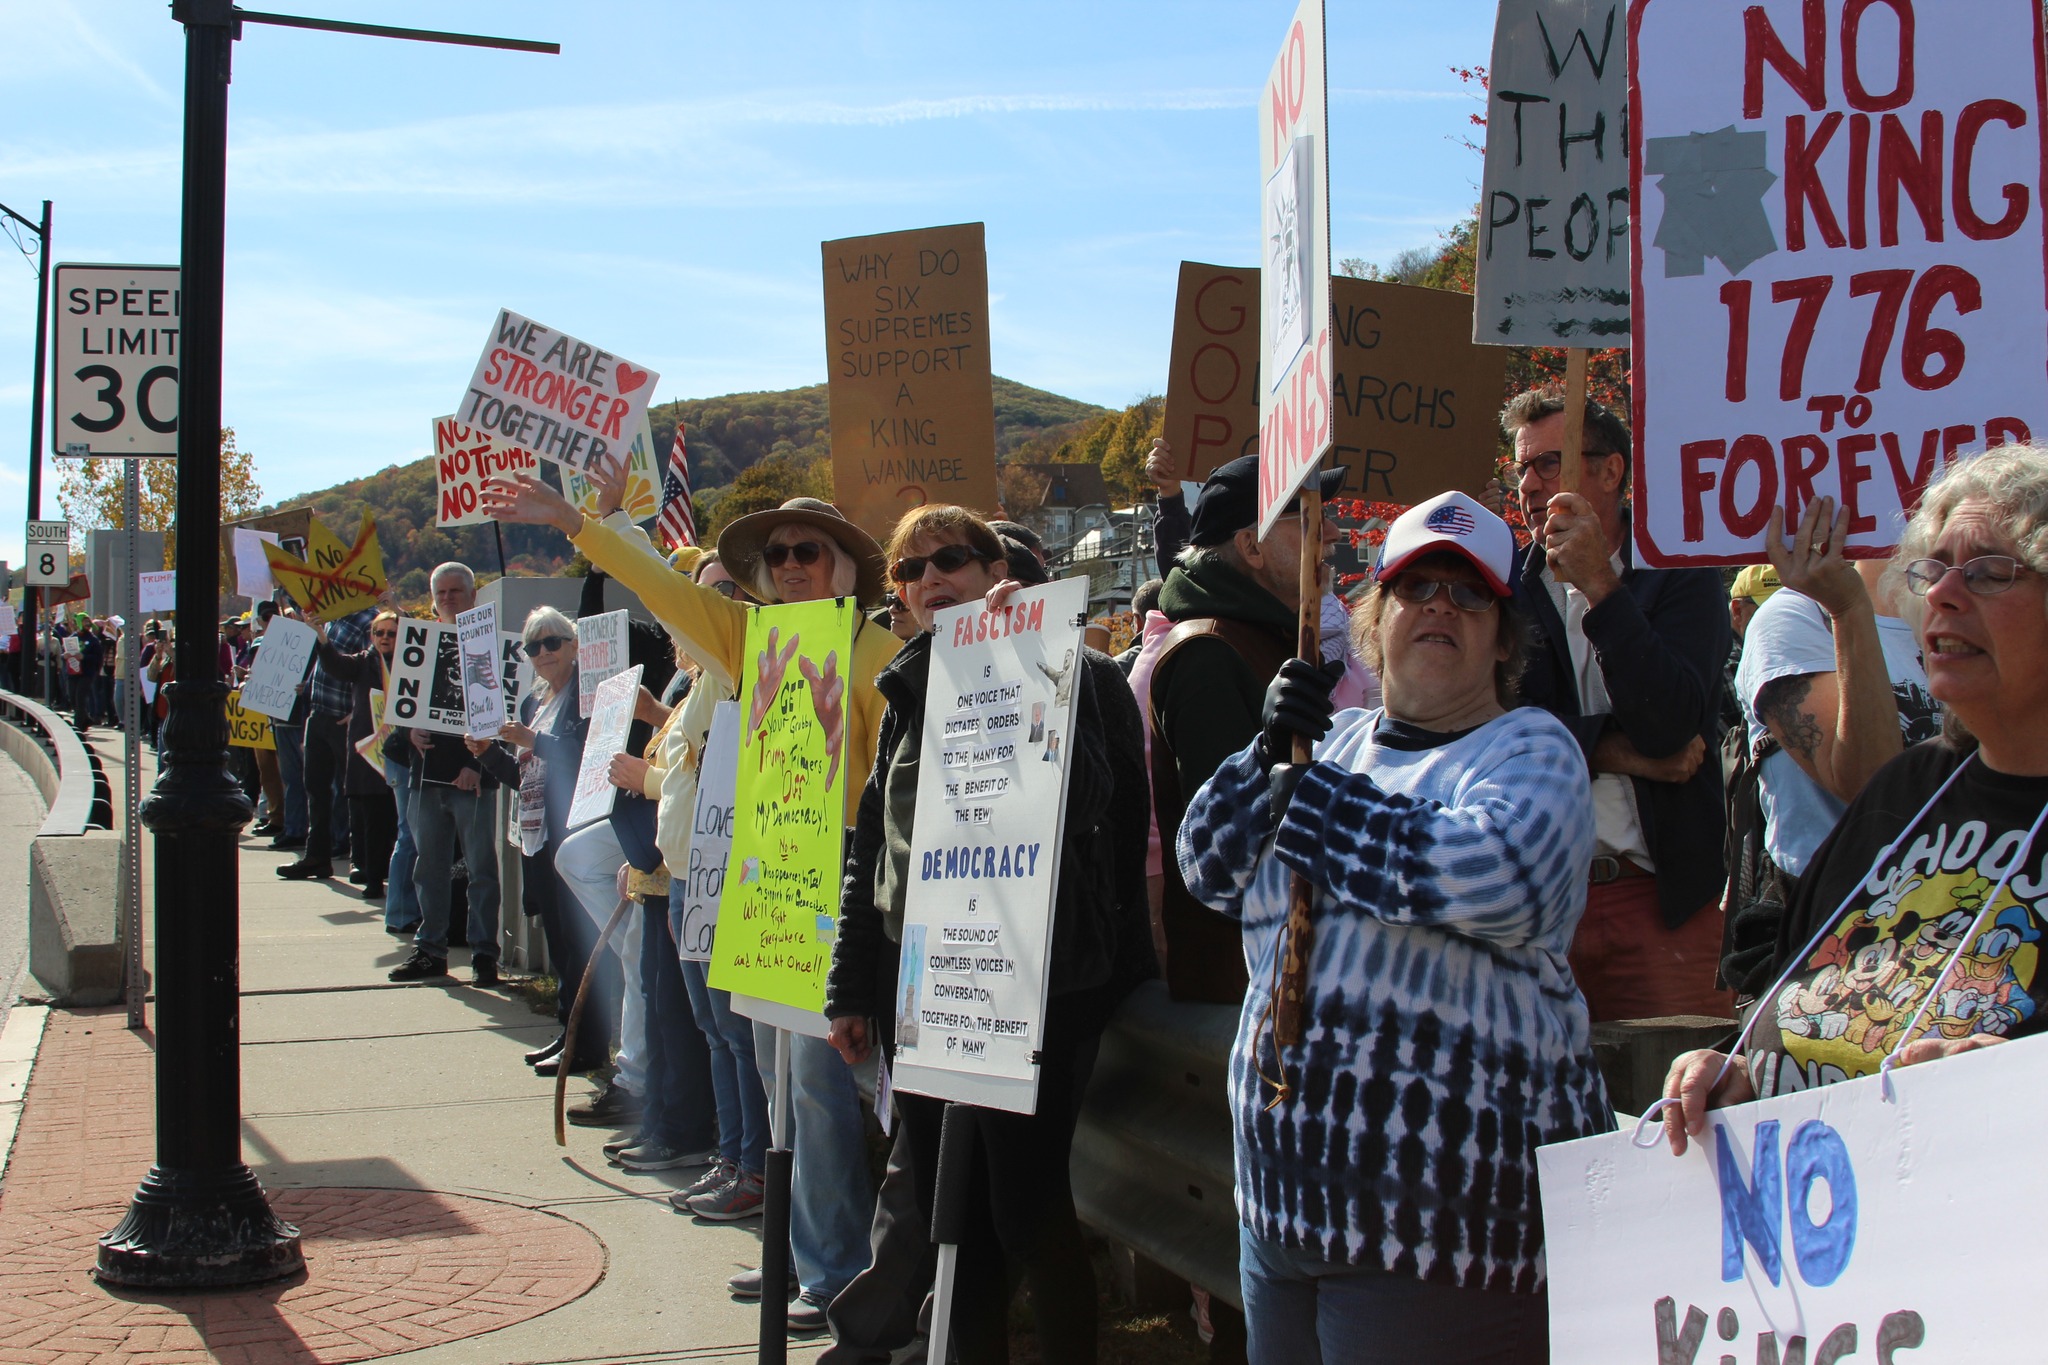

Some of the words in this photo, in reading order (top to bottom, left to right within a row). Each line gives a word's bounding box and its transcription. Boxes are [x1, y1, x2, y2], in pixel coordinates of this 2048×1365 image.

[1536, 3, 1628, 81] W
[1743, 0, 1916, 119] NO
[1271, 20, 1305, 170] NO
[1496, 90, 1629, 172] TH
[1784, 98, 2030, 252] KING
[1485, 187, 1630, 263] PEOP
[839, 252, 893, 284] WHY
[919, 248, 961, 277] DO
[68, 287, 180, 317] SPEE
[875, 285, 920, 313] SIX
[82, 328, 179, 355] LIMIT
[839, 311, 972, 347] SUPREMES
[1719, 264, 1983, 402] 1776
[497, 311, 548, 357] WE
[541, 335, 613, 388] ARE
[840, 344, 972, 378] SUPPORT
[70, 364, 178, 434] 30
[484, 348, 630, 440] STRONGER
[895, 382, 914, 408] A
[1258, 328, 1329, 525] KINGS
[1806, 394, 1873, 433] TO
[468, 387, 608, 475] TOGETHER
[870, 418, 937, 448] KING
[862, 457, 968, 486] WANNABE
[1680, 416, 2031, 543] FOREV
[441, 482, 478, 522] NO
[28, 523, 67, 538] SOUTH
[40, 553, 55, 576] 8
[300, 565, 377, 614] KINGS
[457, 614, 476, 629] SAVE
[477, 608, 493, 621] OUR
[460, 623, 495, 642] COUNTRY
[953, 598, 1045, 648] FASCISM
[281, 631, 301, 650] NO
[609, 639, 618, 666] IS
[259, 647, 306, 674] KINGS
[983, 665, 992, 678] IS
[241, 680, 294, 709] AMERICA
[271, 673, 284, 687] IN
[226, 697, 245, 717] NO
[957, 693, 973, 708] ONE
[974, 689, 998, 705] VOICE
[999, 684, 1021, 701] THAT
[446, 710, 464, 718] NOT
[945, 718, 980, 735] DICTATES
[987, 712, 1020, 730] ORDERS
[229, 719, 266, 742] NGS!
[943, 752, 954, 765] TO
[955, 750, 969, 764] THE
[972, 747, 996, 763] MANY
[997, 744, 1014, 758] FOR
[945, 783, 958, 796] THE
[964, 779, 997, 795] BENEFIT
[997, 777, 1009, 791] OF
[955, 809, 969, 822] THE
[973, 807, 990, 821] FEW
[687, 848, 727, 898] Prot
[921, 842, 1040, 881] DEMOCRACY
[968, 898, 977, 912] IS
[683, 904, 717, 955] Co
[943, 928, 957, 941] THE
[958, 928, 986, 943] SOUND
[987, 929, 998, 943] OF
[930, 955, 971, 971] COUNTLESS
[975, 958, 1004, 972] VOICES
[1004, 959, 1014, 973] IN
[934, 984, 991, 1002] CONVERSATION
[921, 1010, 959, 1028] TOGETHER
[959, 1014, 976, 1030] FOR
[977, 1017, 992, 1031] THE
[994, 1020, 1028, 1035] BENEFIT
[946, 1036, 957, 1049] OF
[962, 1038, 985, 1055] MANY
[1715, 1119, 1859, 1288] NO
